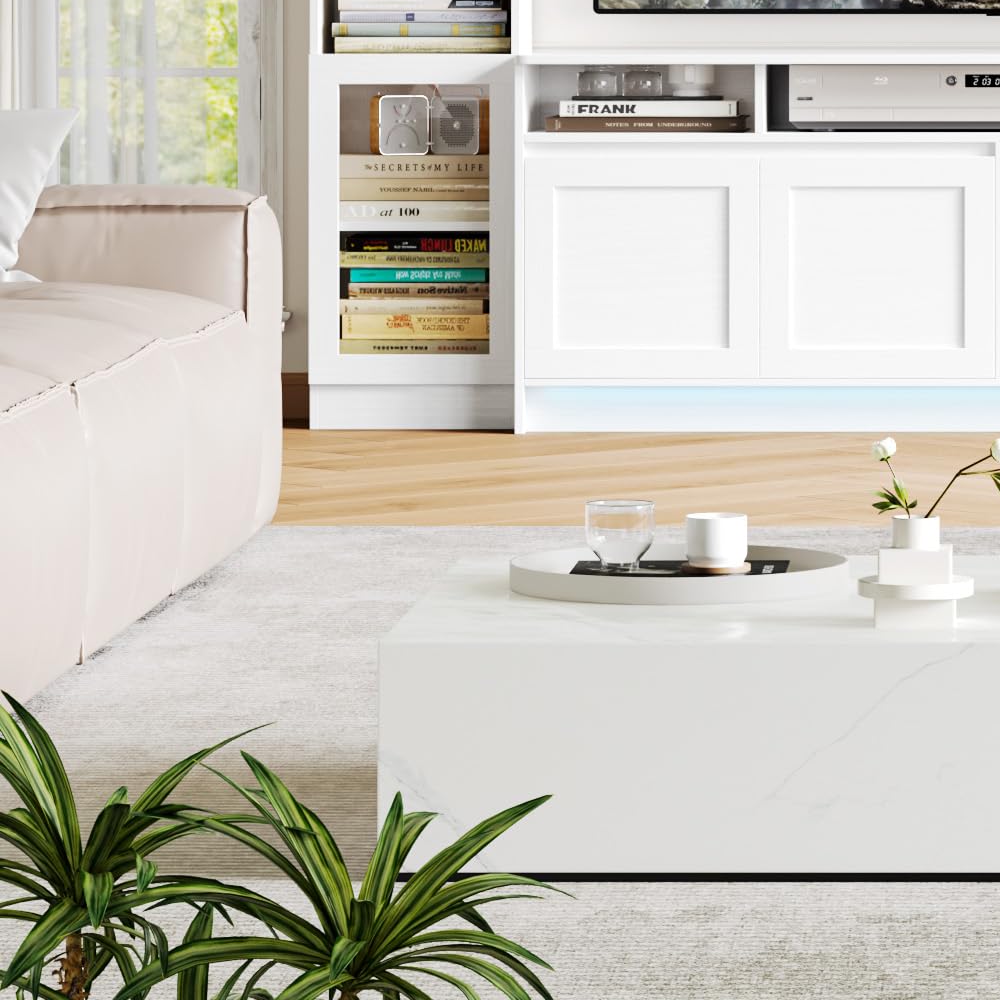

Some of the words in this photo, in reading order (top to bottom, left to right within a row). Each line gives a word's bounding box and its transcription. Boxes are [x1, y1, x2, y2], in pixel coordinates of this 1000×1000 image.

[981, 77, 992, 86] 03
[577, 104, 637, 114] FRANK
[373, 164, 426, 172] SECRETS
[433, 164, 450, 172] MY
[457, 164, 484, 172] LIFE
[380, 207, 393, 217] at
[399, 207, 420, 217] 100
